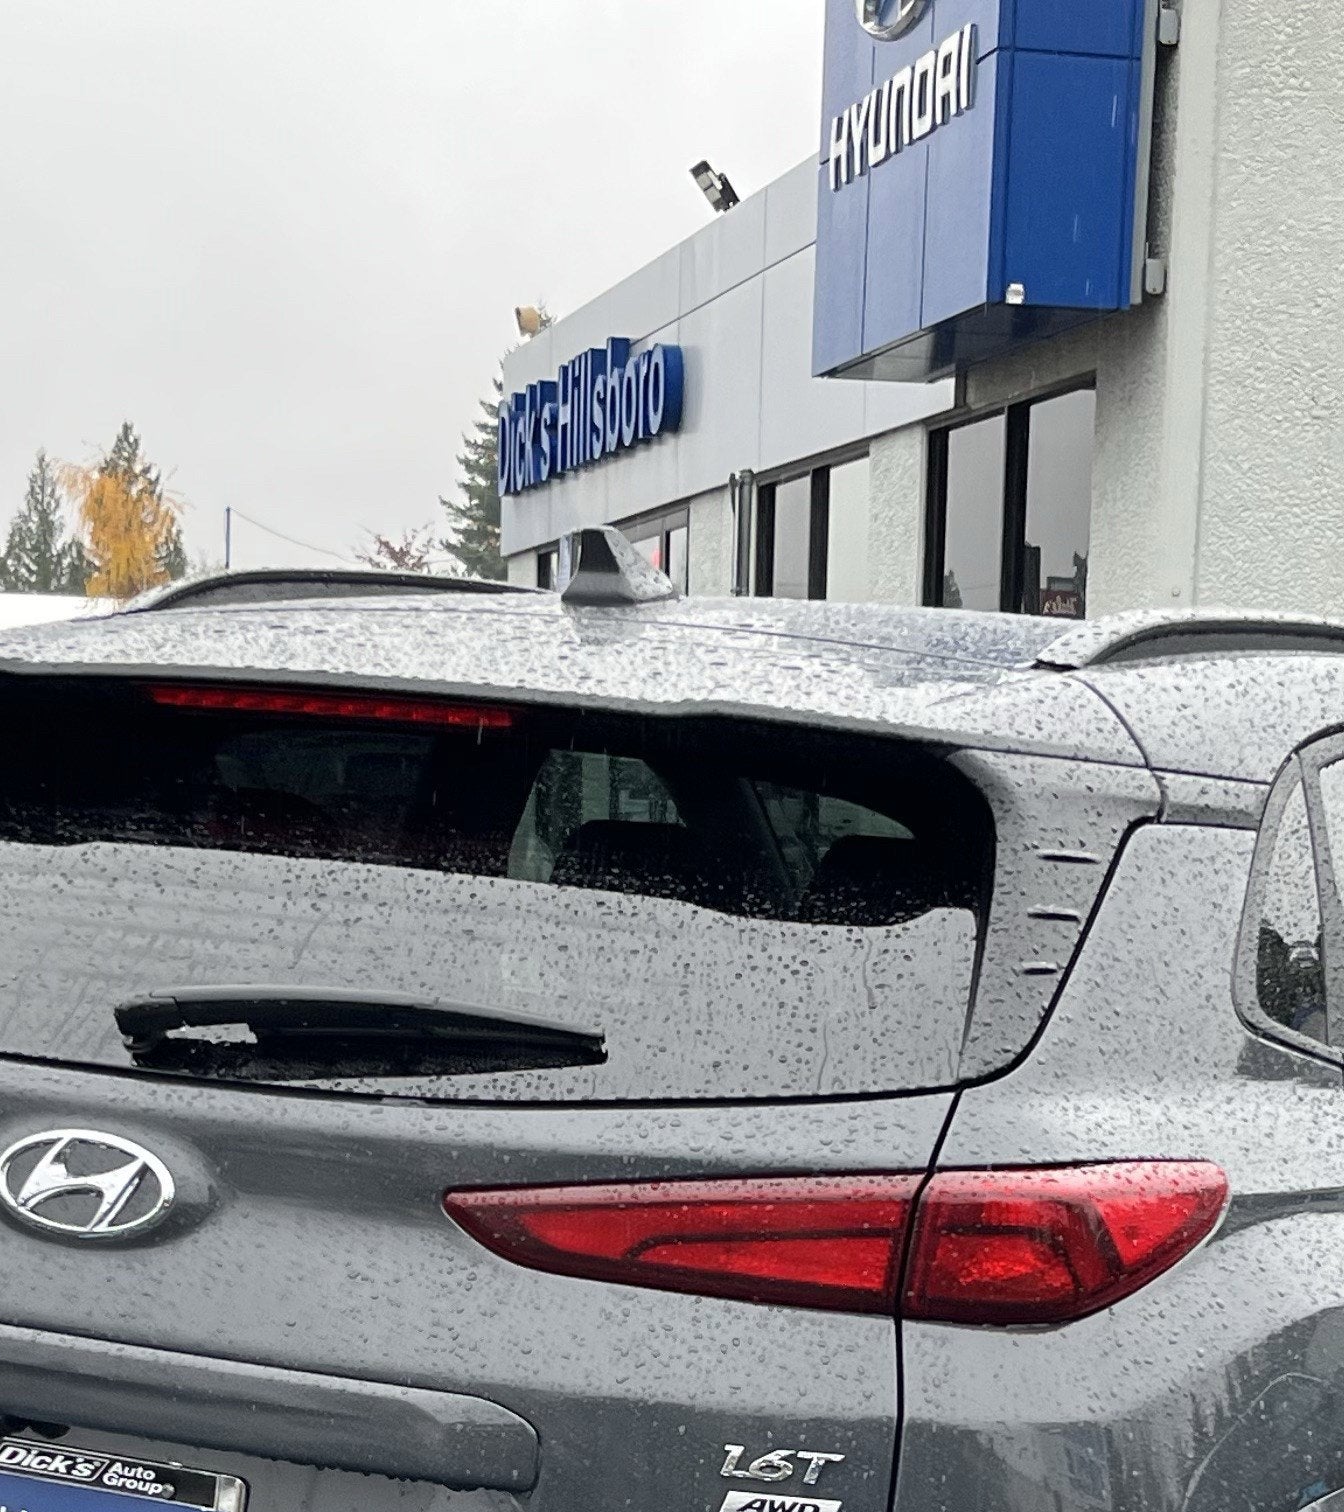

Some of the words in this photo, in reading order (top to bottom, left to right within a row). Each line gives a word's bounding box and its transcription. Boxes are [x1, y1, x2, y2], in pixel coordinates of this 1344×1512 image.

[829, 23, 974, 192] HYUNDAI
[498, 380, 552, 497] Dick's
[558, 337, 666, 473] Hillsboro
[102, 1472, 164, 1496] Group
[107, 1462, 156, 1481] Auto
